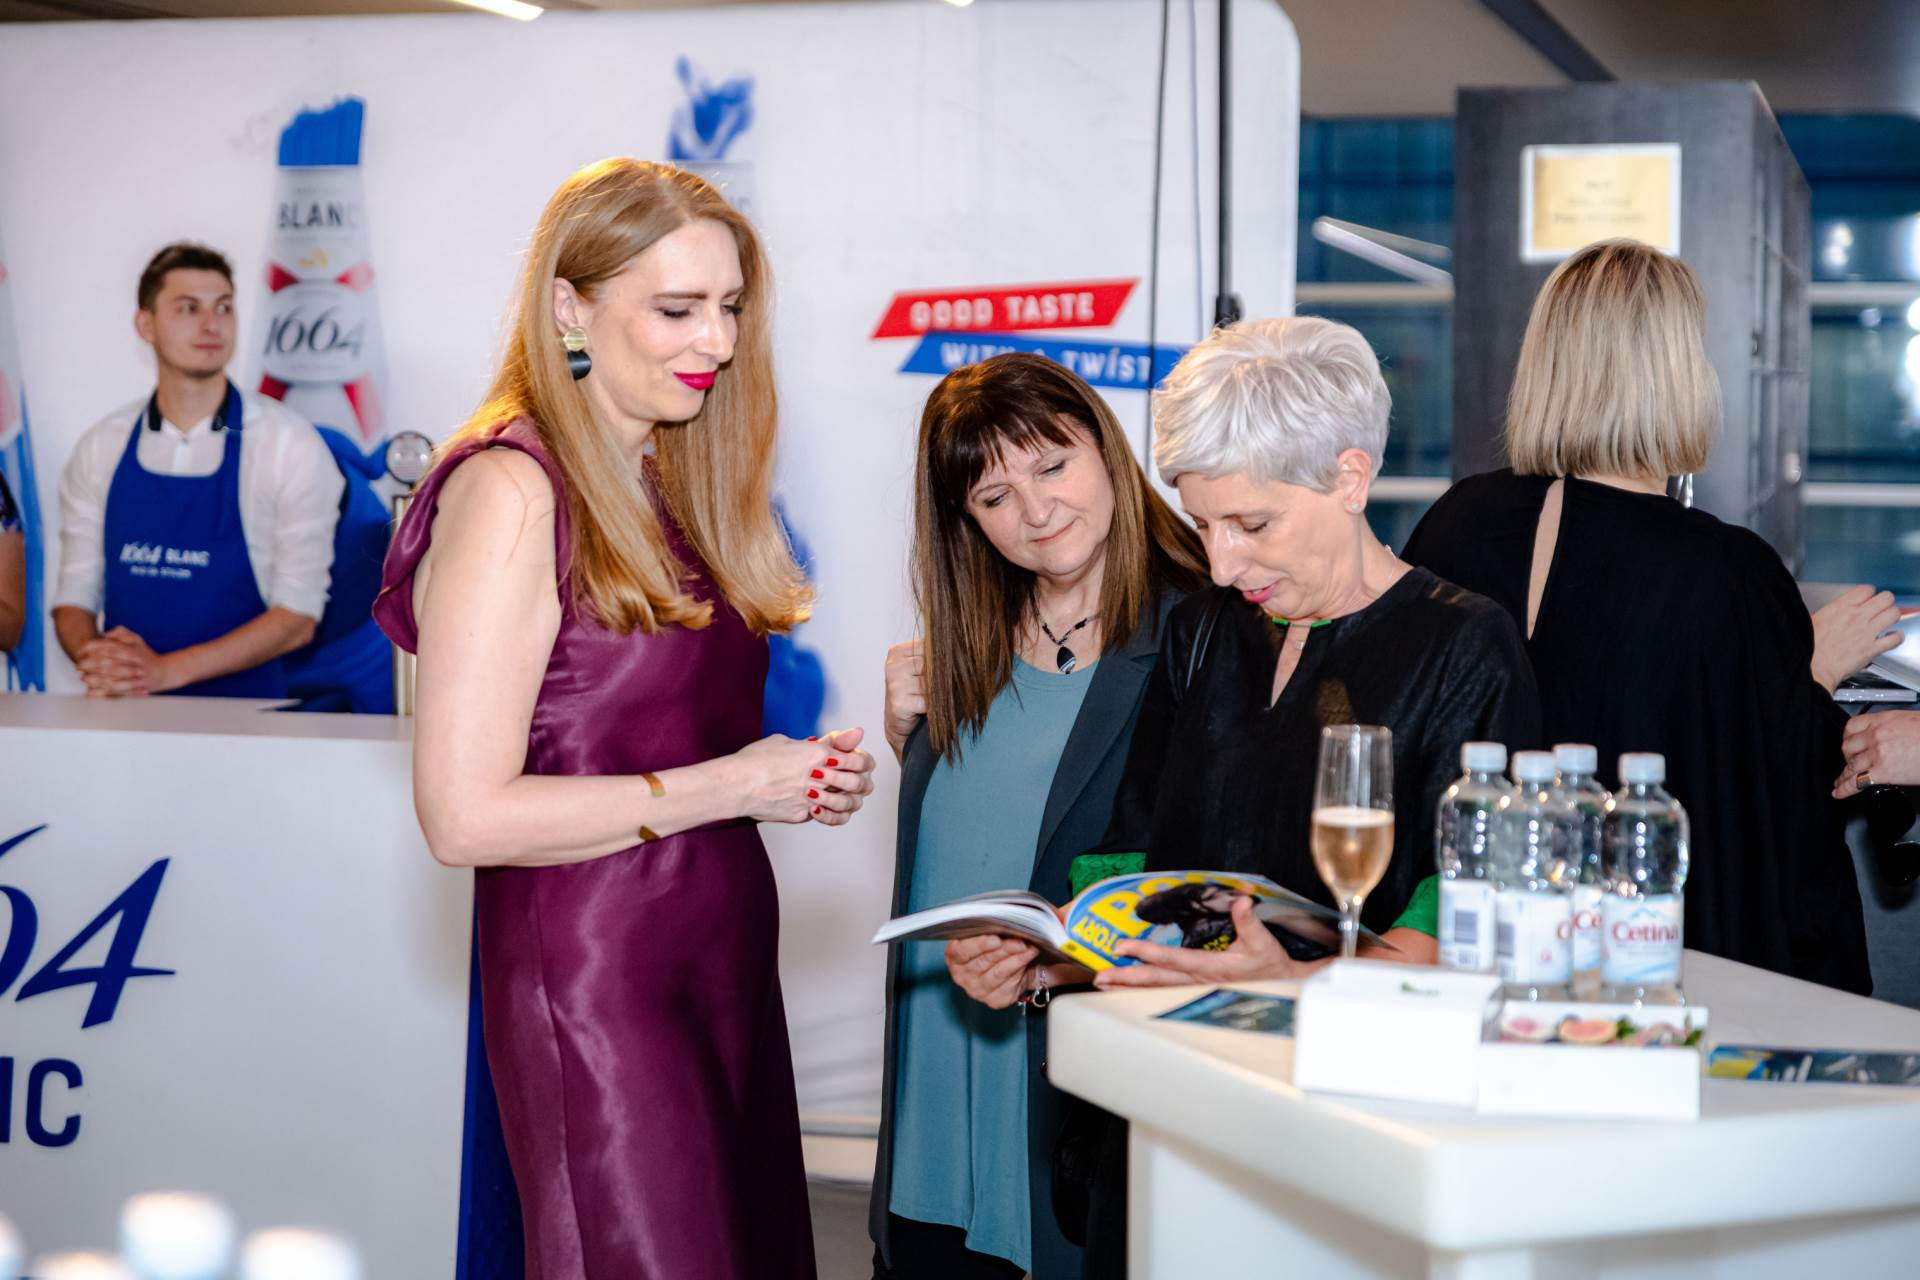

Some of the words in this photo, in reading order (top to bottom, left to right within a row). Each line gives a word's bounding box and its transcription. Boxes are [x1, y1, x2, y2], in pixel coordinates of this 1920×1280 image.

[910, 297, 993, 329] GOOD
[1004, 292, 1095, 324] TASTE
[264, 304, 364, 356] 1664
[120, 541, 163, 565] 1664
[165, 547, 210, 567] BLANC
[1071, 916, 1119, 960] TORY
[1612, 921, 1679, 942] Cetina
